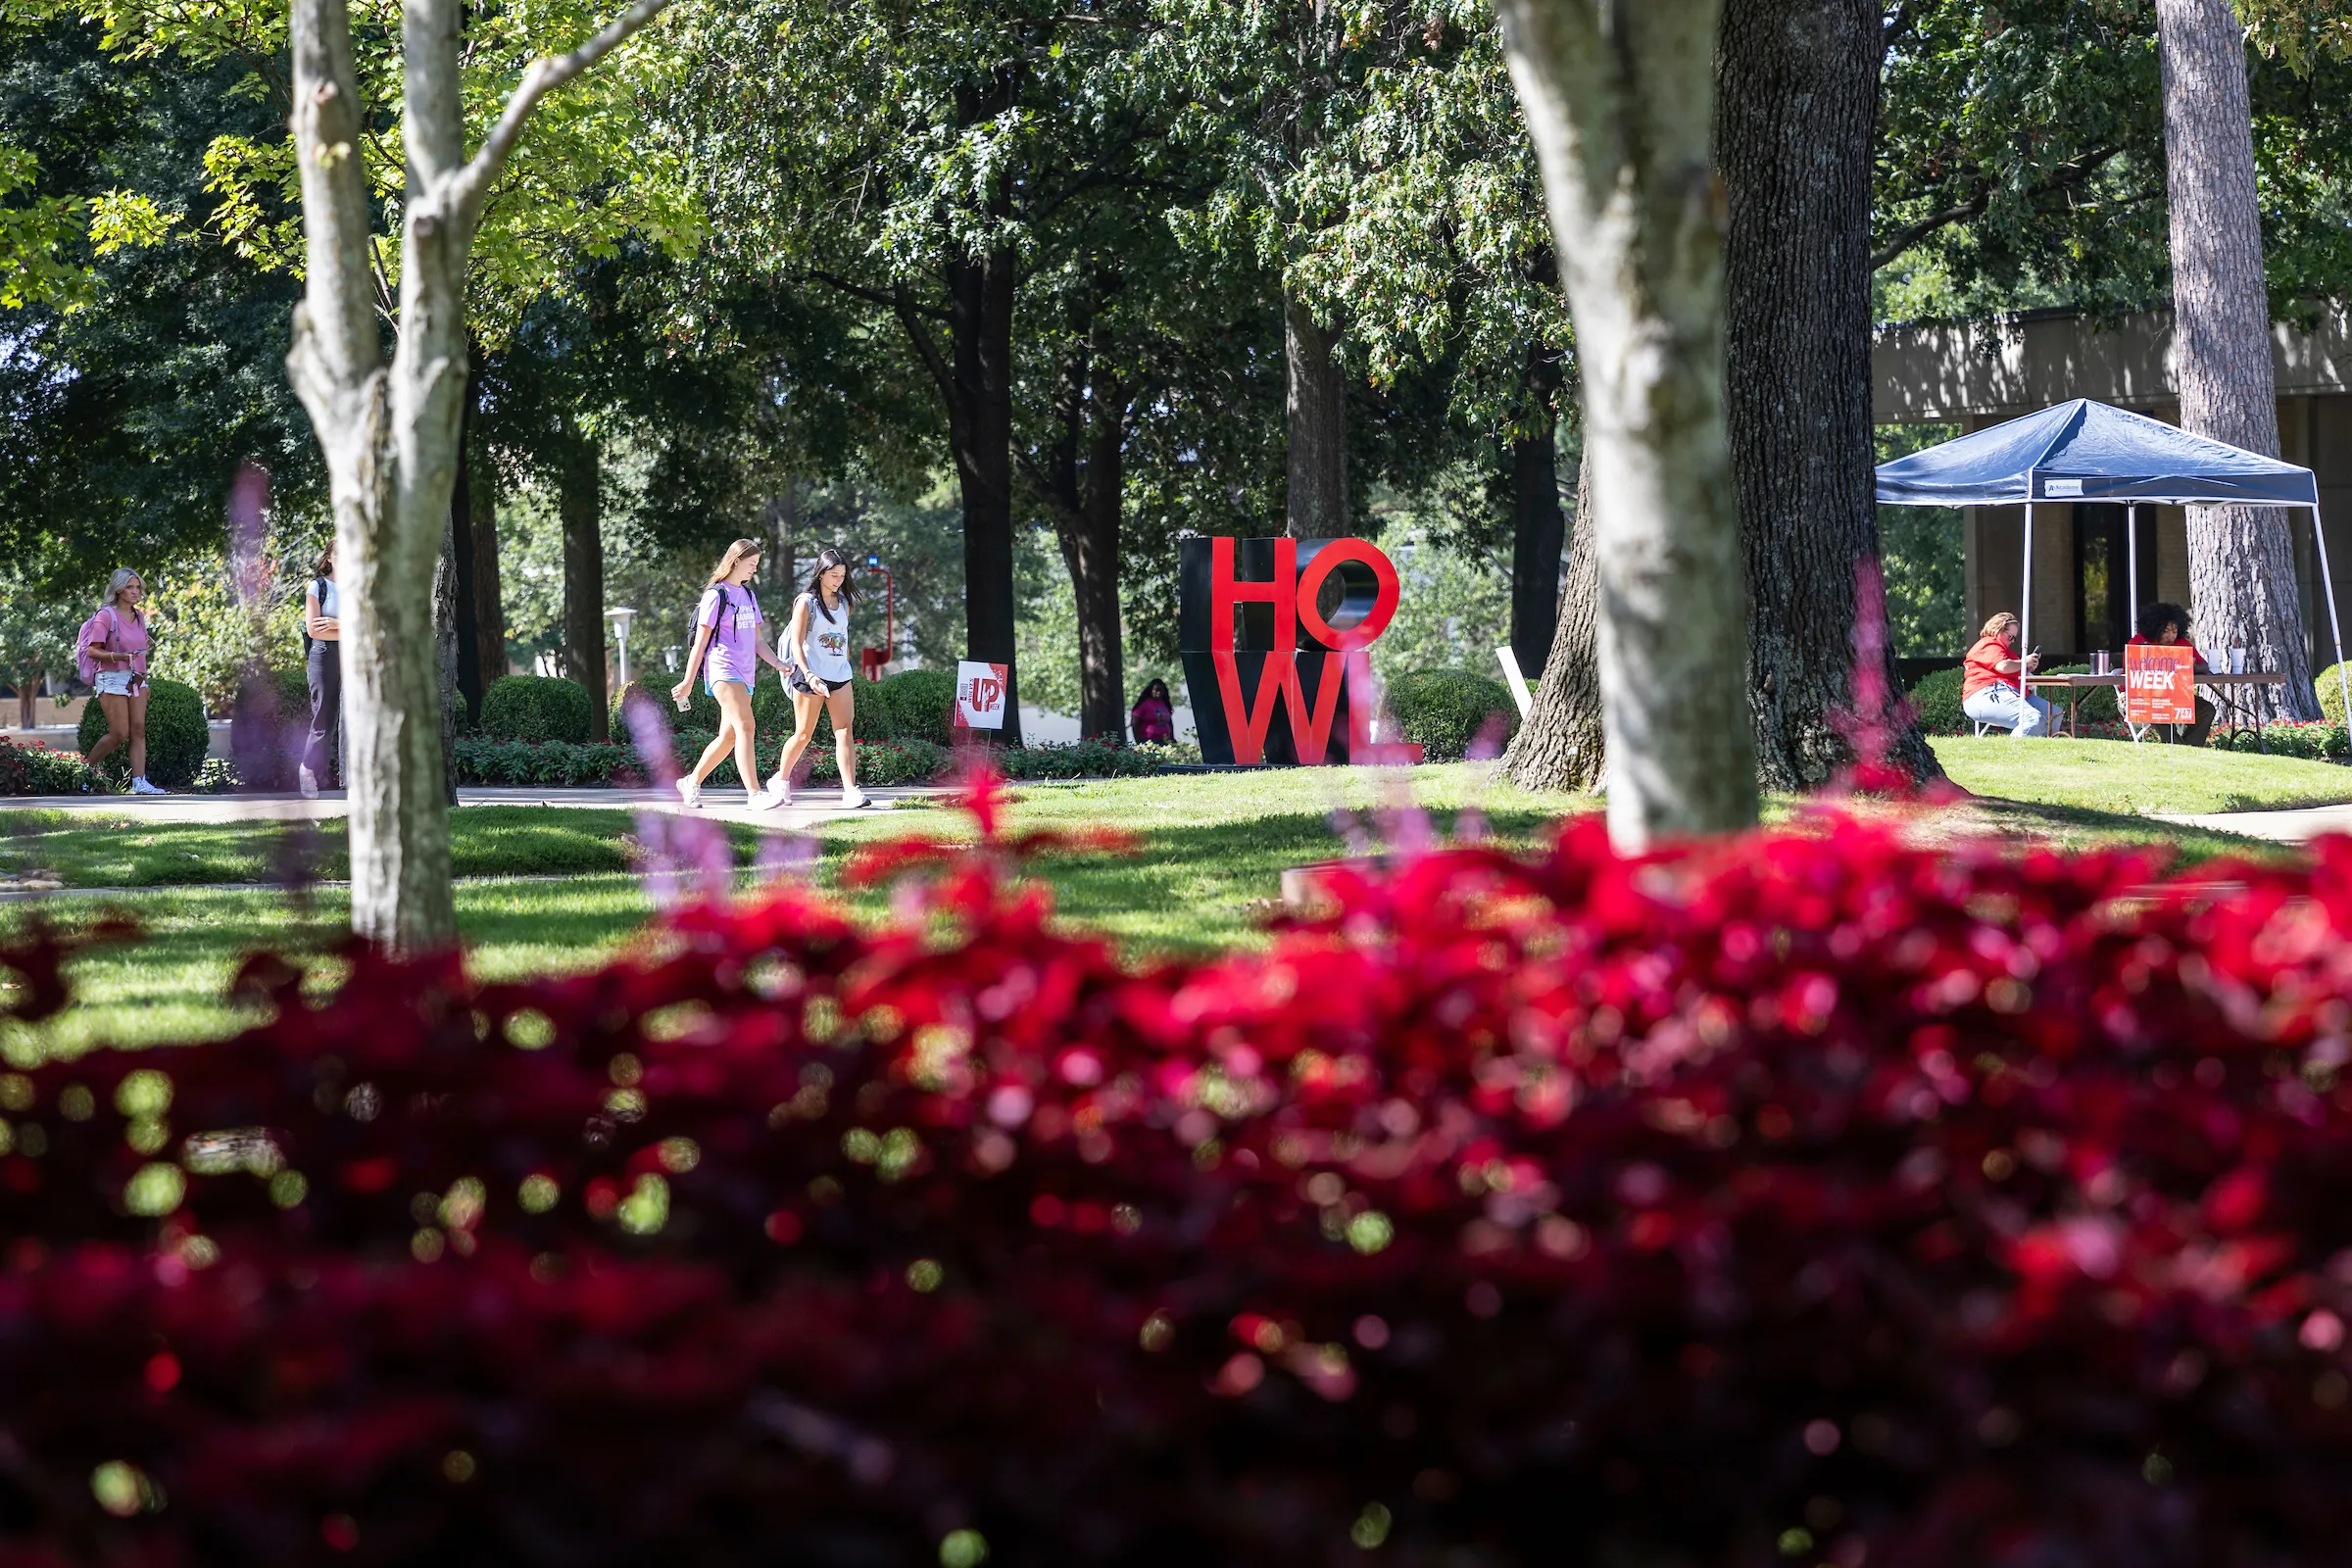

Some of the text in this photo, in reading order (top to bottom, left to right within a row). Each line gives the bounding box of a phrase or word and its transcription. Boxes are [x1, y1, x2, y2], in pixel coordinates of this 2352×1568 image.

[1211, 536, 1400, 652] HO
[2129, 647, 2180, 674] welcome
[972, 677, 1000, 712] UP
[2130, 669, 2175, 690] WEEK
[1211, 650, 1424, 765] WL
